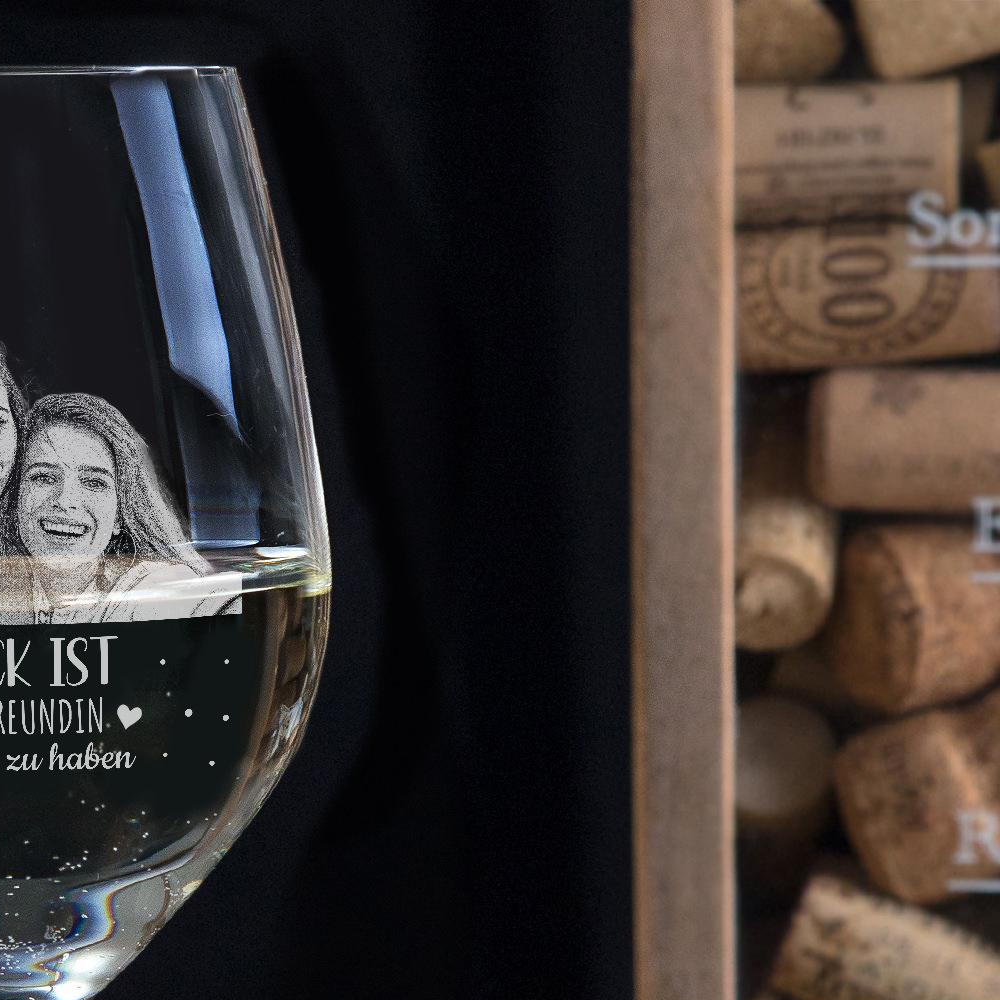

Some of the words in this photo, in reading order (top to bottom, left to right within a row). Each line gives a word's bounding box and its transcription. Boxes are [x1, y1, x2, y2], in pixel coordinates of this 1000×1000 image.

[49, 635, 119, 687] IST
[6, 753, 44, 771] zu
[48, 742, 137, 771] haben
